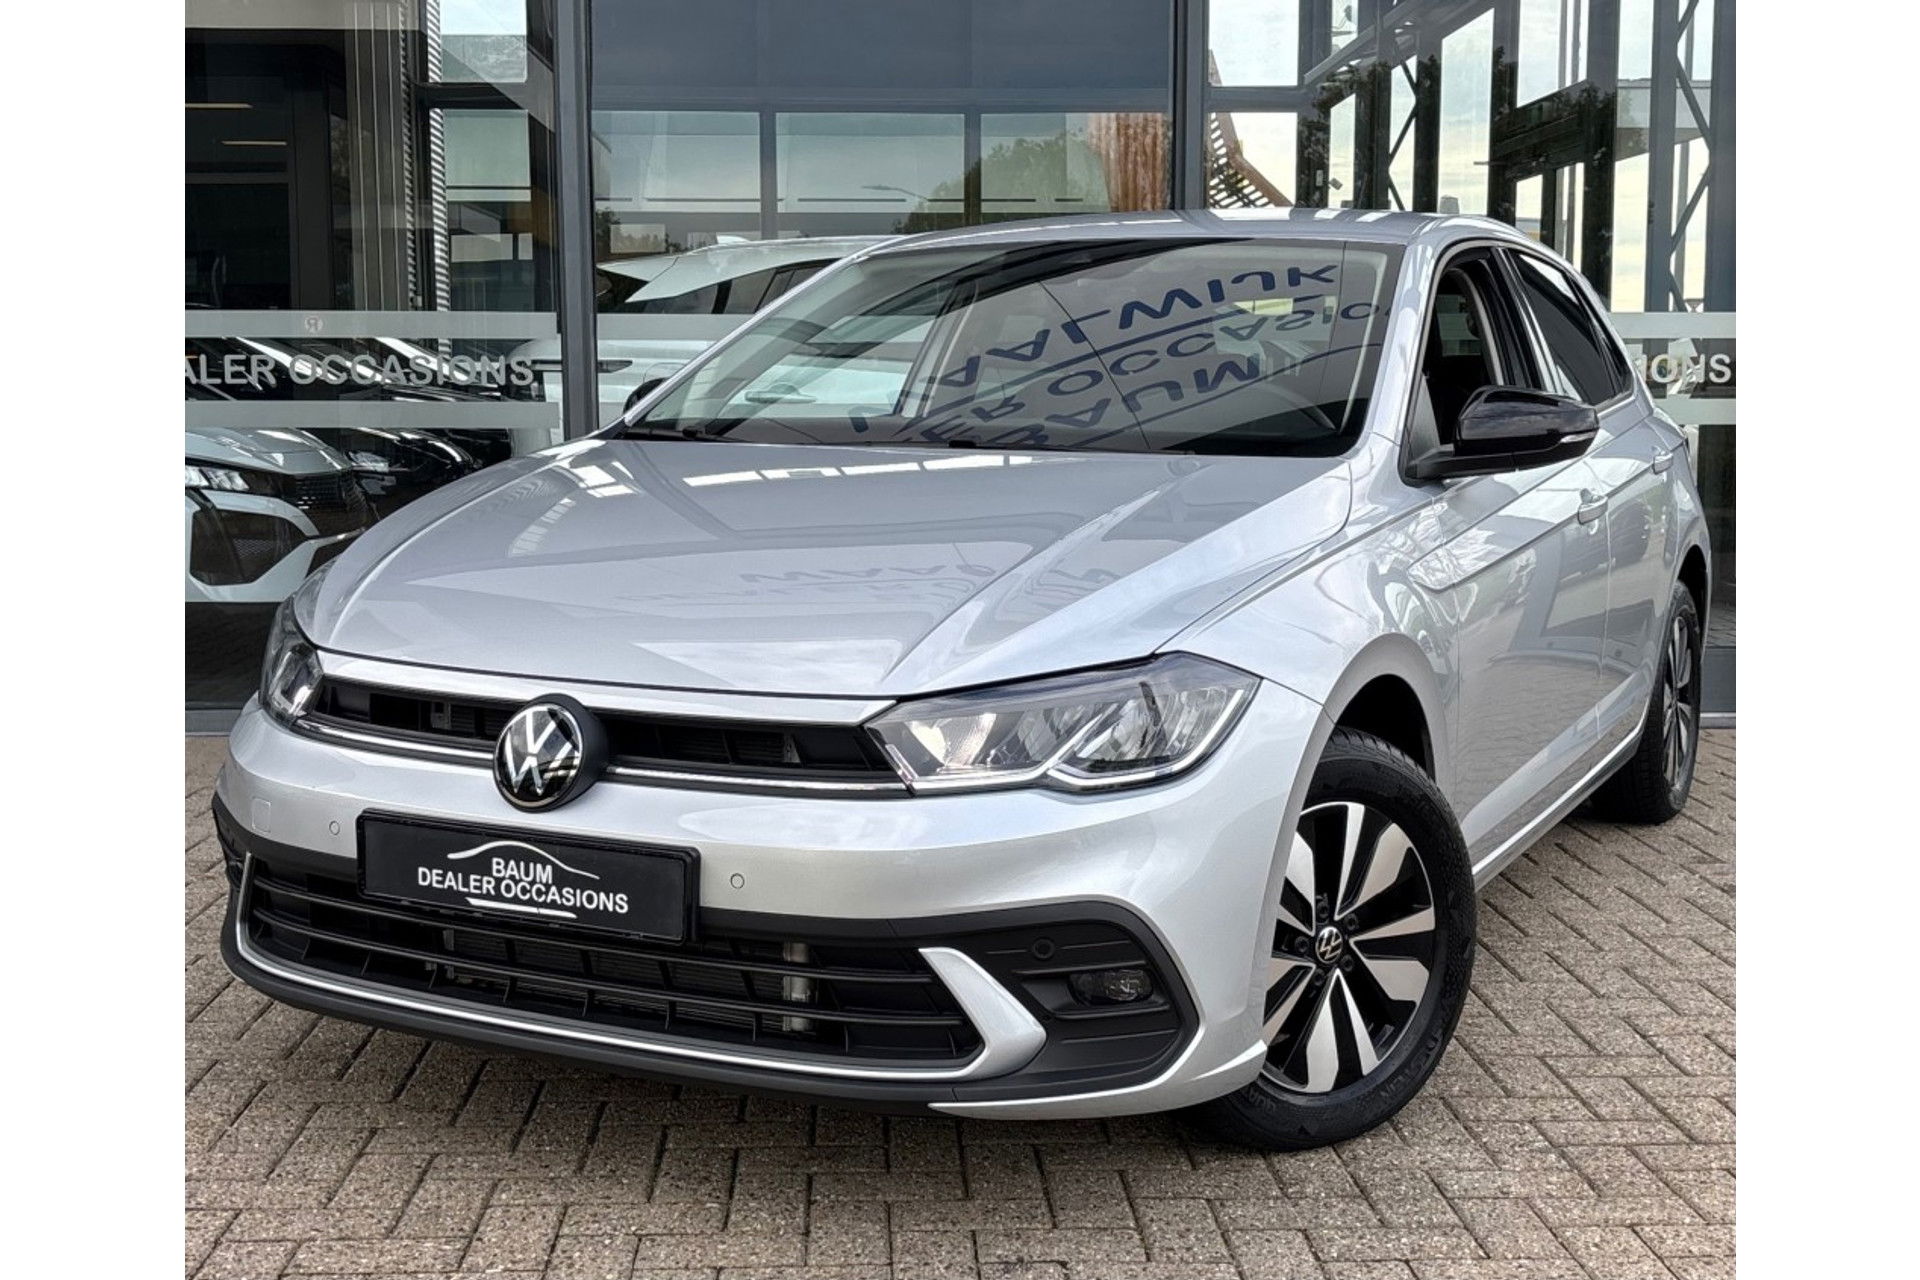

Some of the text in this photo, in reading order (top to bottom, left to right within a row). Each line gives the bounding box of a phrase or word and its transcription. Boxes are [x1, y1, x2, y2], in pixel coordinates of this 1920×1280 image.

[289, 353, 535, 386] OCCASIONS
[491, 857, 553, 884] BAUM
[417, 867, 629, 914] DEALER OCCASIONS
